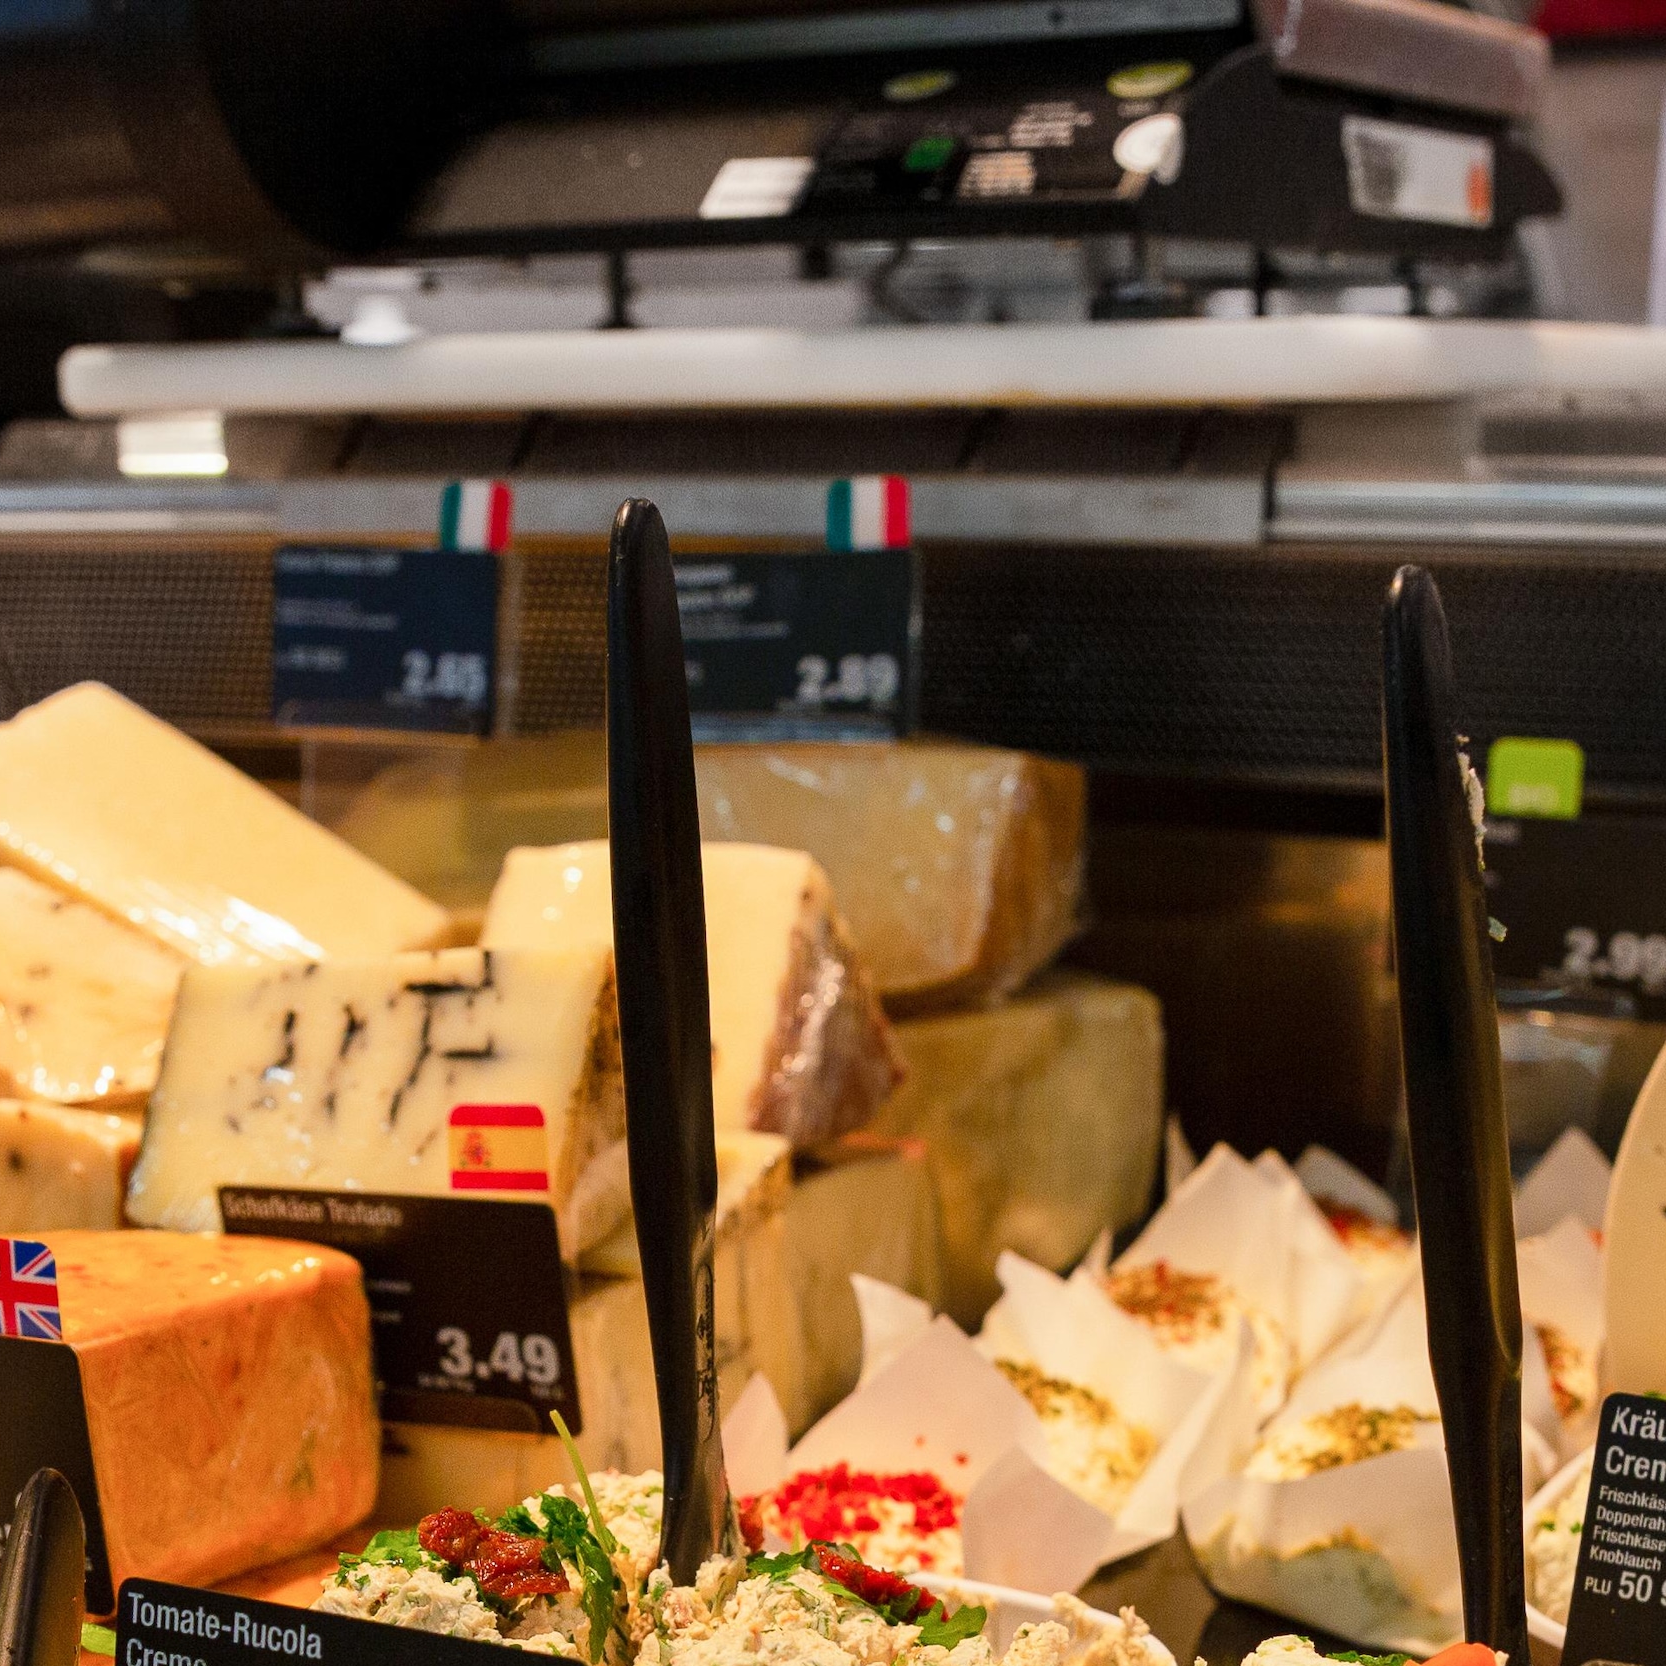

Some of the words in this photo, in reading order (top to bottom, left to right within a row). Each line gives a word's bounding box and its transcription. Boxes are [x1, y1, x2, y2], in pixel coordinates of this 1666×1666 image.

[436, 1327, 560, 1384] 3.49
[1592, 1525, 1666, 1554] Frischkäse
[1589, 1545, 1662, 1573] Knoblauch
[1584, 1576, 1611, 1597] PLU
[1617, 1572, 1654, 1604] 50
[127, 1592, 323, 1660] Tomate-Rucola
